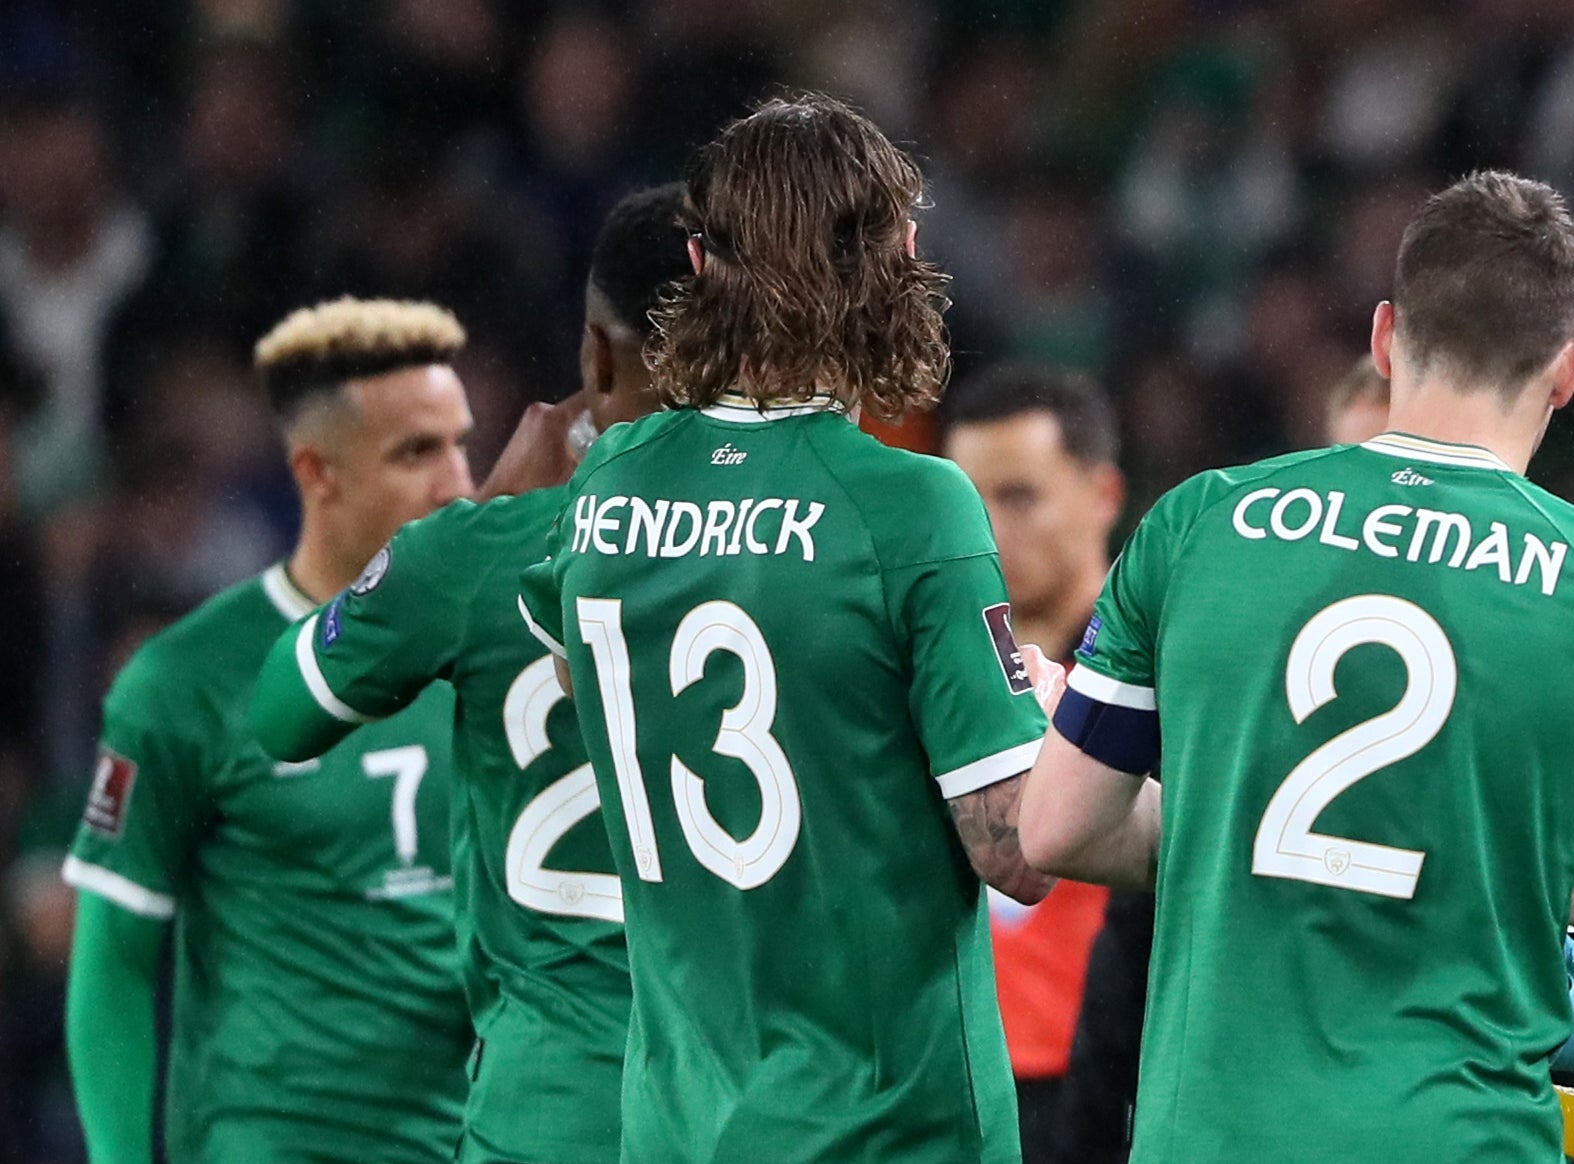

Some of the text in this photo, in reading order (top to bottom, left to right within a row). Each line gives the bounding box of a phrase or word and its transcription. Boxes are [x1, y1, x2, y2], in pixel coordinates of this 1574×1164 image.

[711, 443, 748, 465] Éire
[572, 495, 825, 561] HENDRICK
[1232, 488, 1568, 596] COLEMAN
[576, 596, 801, 890] 13
[1251, 593, 1458, 900] 2
[361, 744, 429, 867] 7
